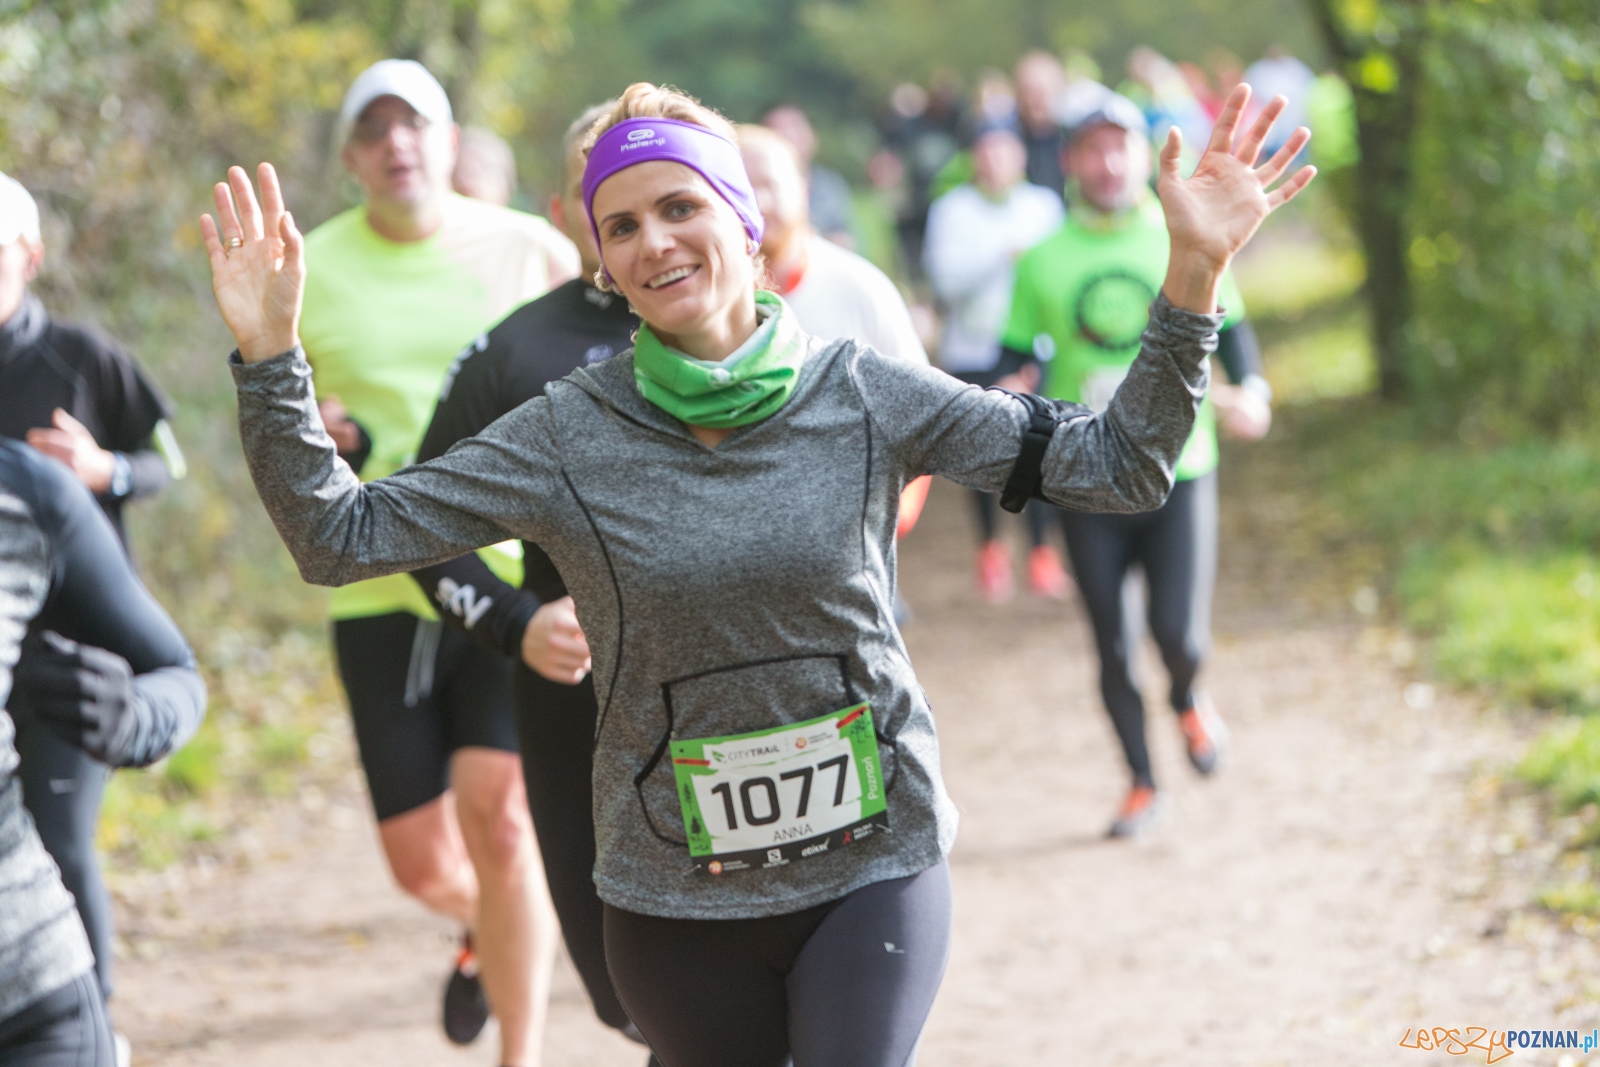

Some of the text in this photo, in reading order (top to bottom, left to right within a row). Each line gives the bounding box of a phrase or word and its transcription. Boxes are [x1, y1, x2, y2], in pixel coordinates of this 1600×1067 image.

[711, 754, 849, 831] 1077
[862, 756, 878, 800] Poznań
[773, 823, 814, 842] ANNA
